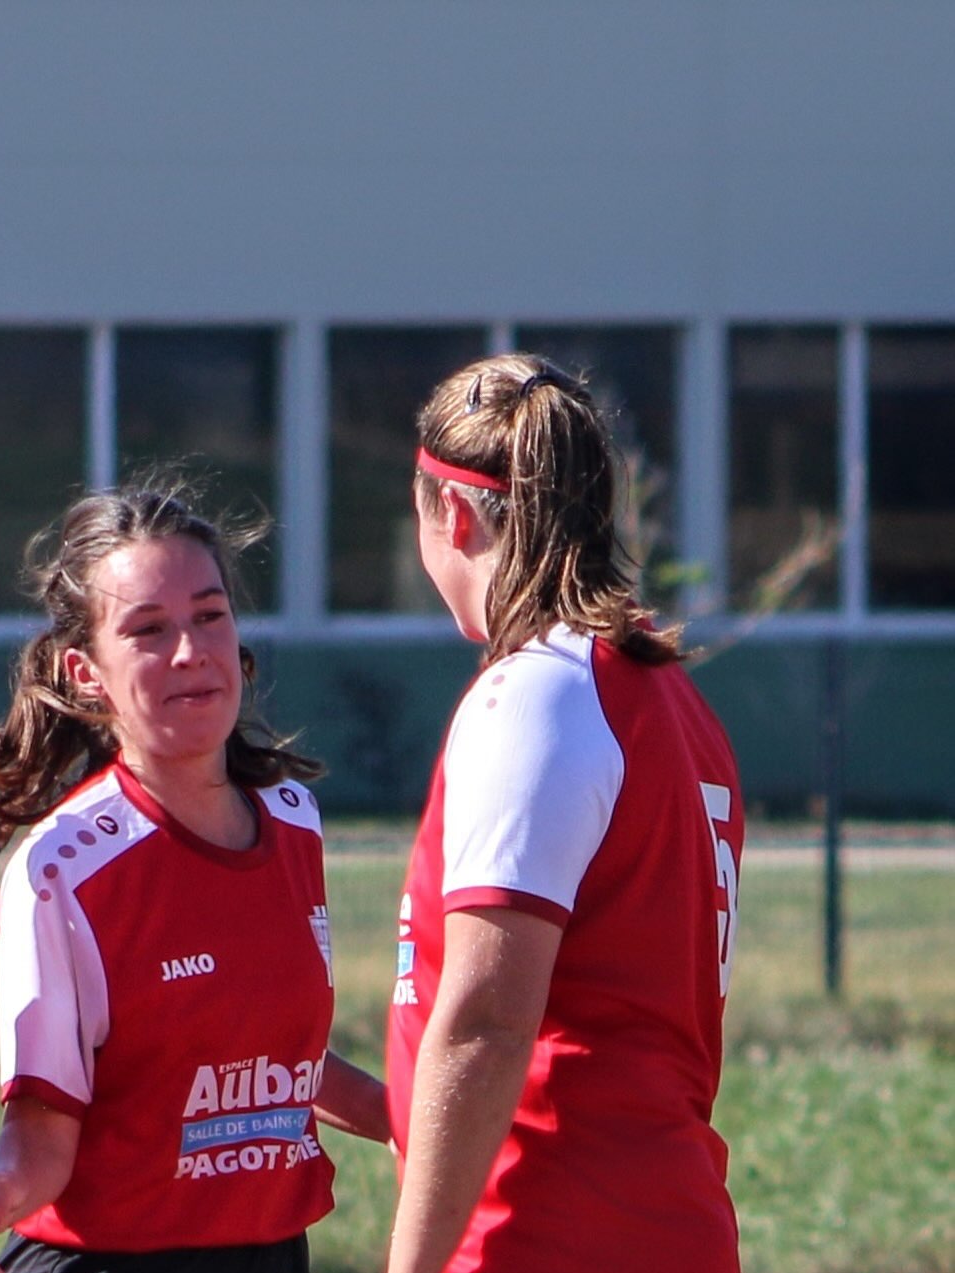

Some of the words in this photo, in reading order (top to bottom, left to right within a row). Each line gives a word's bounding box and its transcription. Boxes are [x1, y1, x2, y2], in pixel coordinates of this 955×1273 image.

[700, 781, 738, 998] 5
[161, 953, 215, 981] JAKO
[219, 1058, 254, 1074] ESPACE
[188, 1121, 223, 1142] SALLE
[226, 1120, 246, 1136] DE
[175, 1146, 281, 1179] PAGOT
